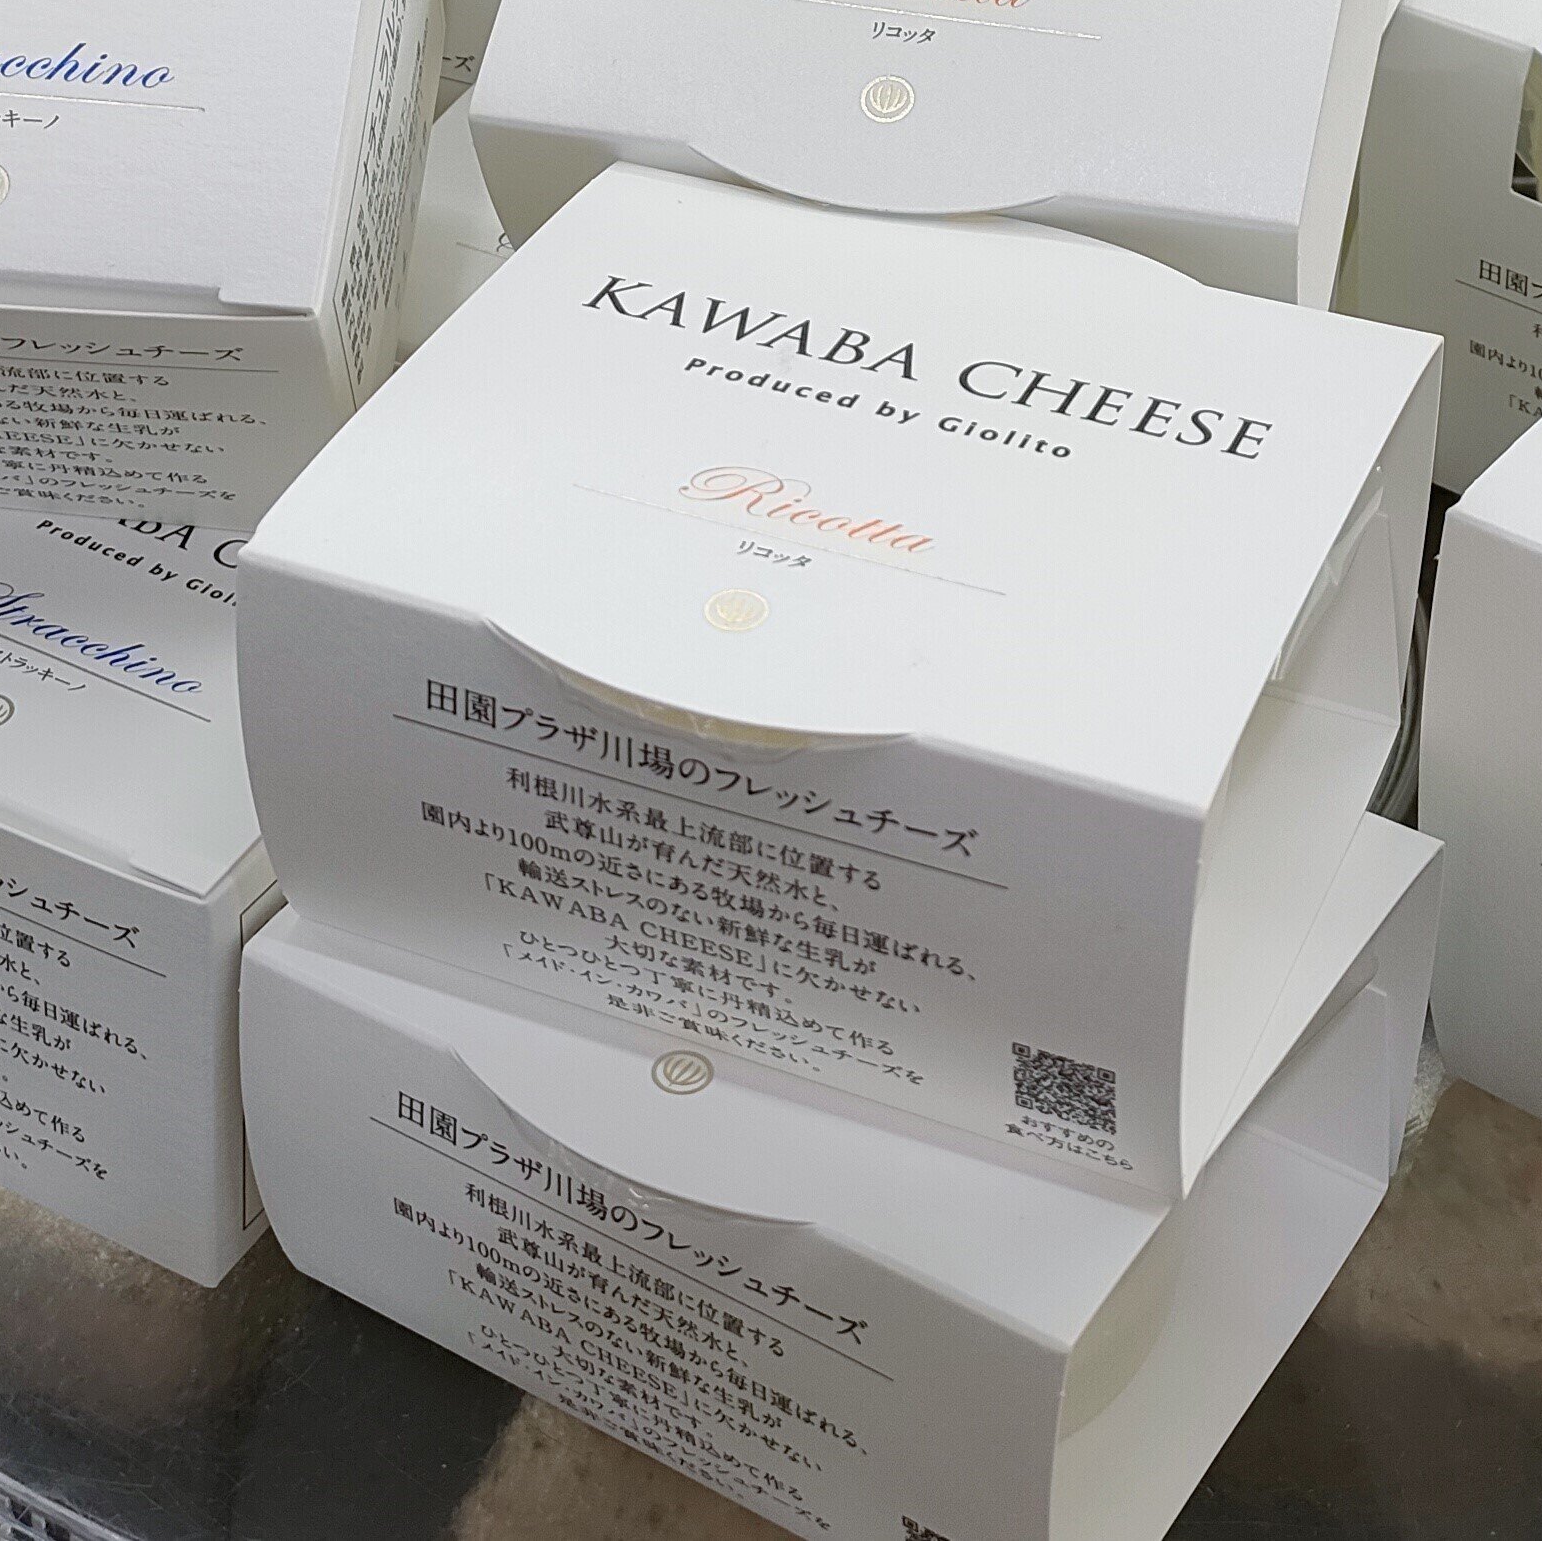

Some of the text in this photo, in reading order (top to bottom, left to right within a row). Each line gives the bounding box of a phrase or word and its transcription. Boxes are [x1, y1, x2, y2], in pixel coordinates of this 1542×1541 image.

[871, 21, 937, 45] リコッタ
[581, 275, 1274, 460] KAWABA CHEESE
[683, 356, 1073, 459] Produced by Giolito
[36, 519, 145, 567] Produced
[149, 563, 178, 582] by
[677, 465, 937, 555] Ricotta
[738, 538, 814, 570] リコッタ
[426, 677, 981, 858] 田園プラザ川場のフレッシュチーズ
[505, 766, 881, 892] 利根川水系最上流部に位置する
[543, 809, 840, 911] 武尊山が育んだ天然水と、
[420, 800, 977, 981] 園内より100mの近さにある牧場から毎日運ばれる、
[481, 871, 922, 1015] 「KAWABA CHEESE」に欠かせない
[517, 858, 878, 977] 輸送ストレスのない新鮮な生乳が
[501, 941, 925, 1086] 「メイド・イン・カワバ」のフレッシュチーズを
[519, 929, 895, 1058] ひとつひとつ丁寧に丹精込めて作る
[605, 935, 793, 1006] 大切な素材です。
[605, 993, 822, 1074] 是非ご賞味ください。
[1005, 1122, 1135, 1172] 食べ方はこちら
[1020, 1114, 1116, 1152] おすすめの
[397, 1090, 870, 1345] 田園プラザ川場のフレッシュチーズ
[464, 1182, 786, 1358] 利根川水系最上流部に位置する
[497, 1226, 749, 1367] 武尊山が育んだ天然水と、
